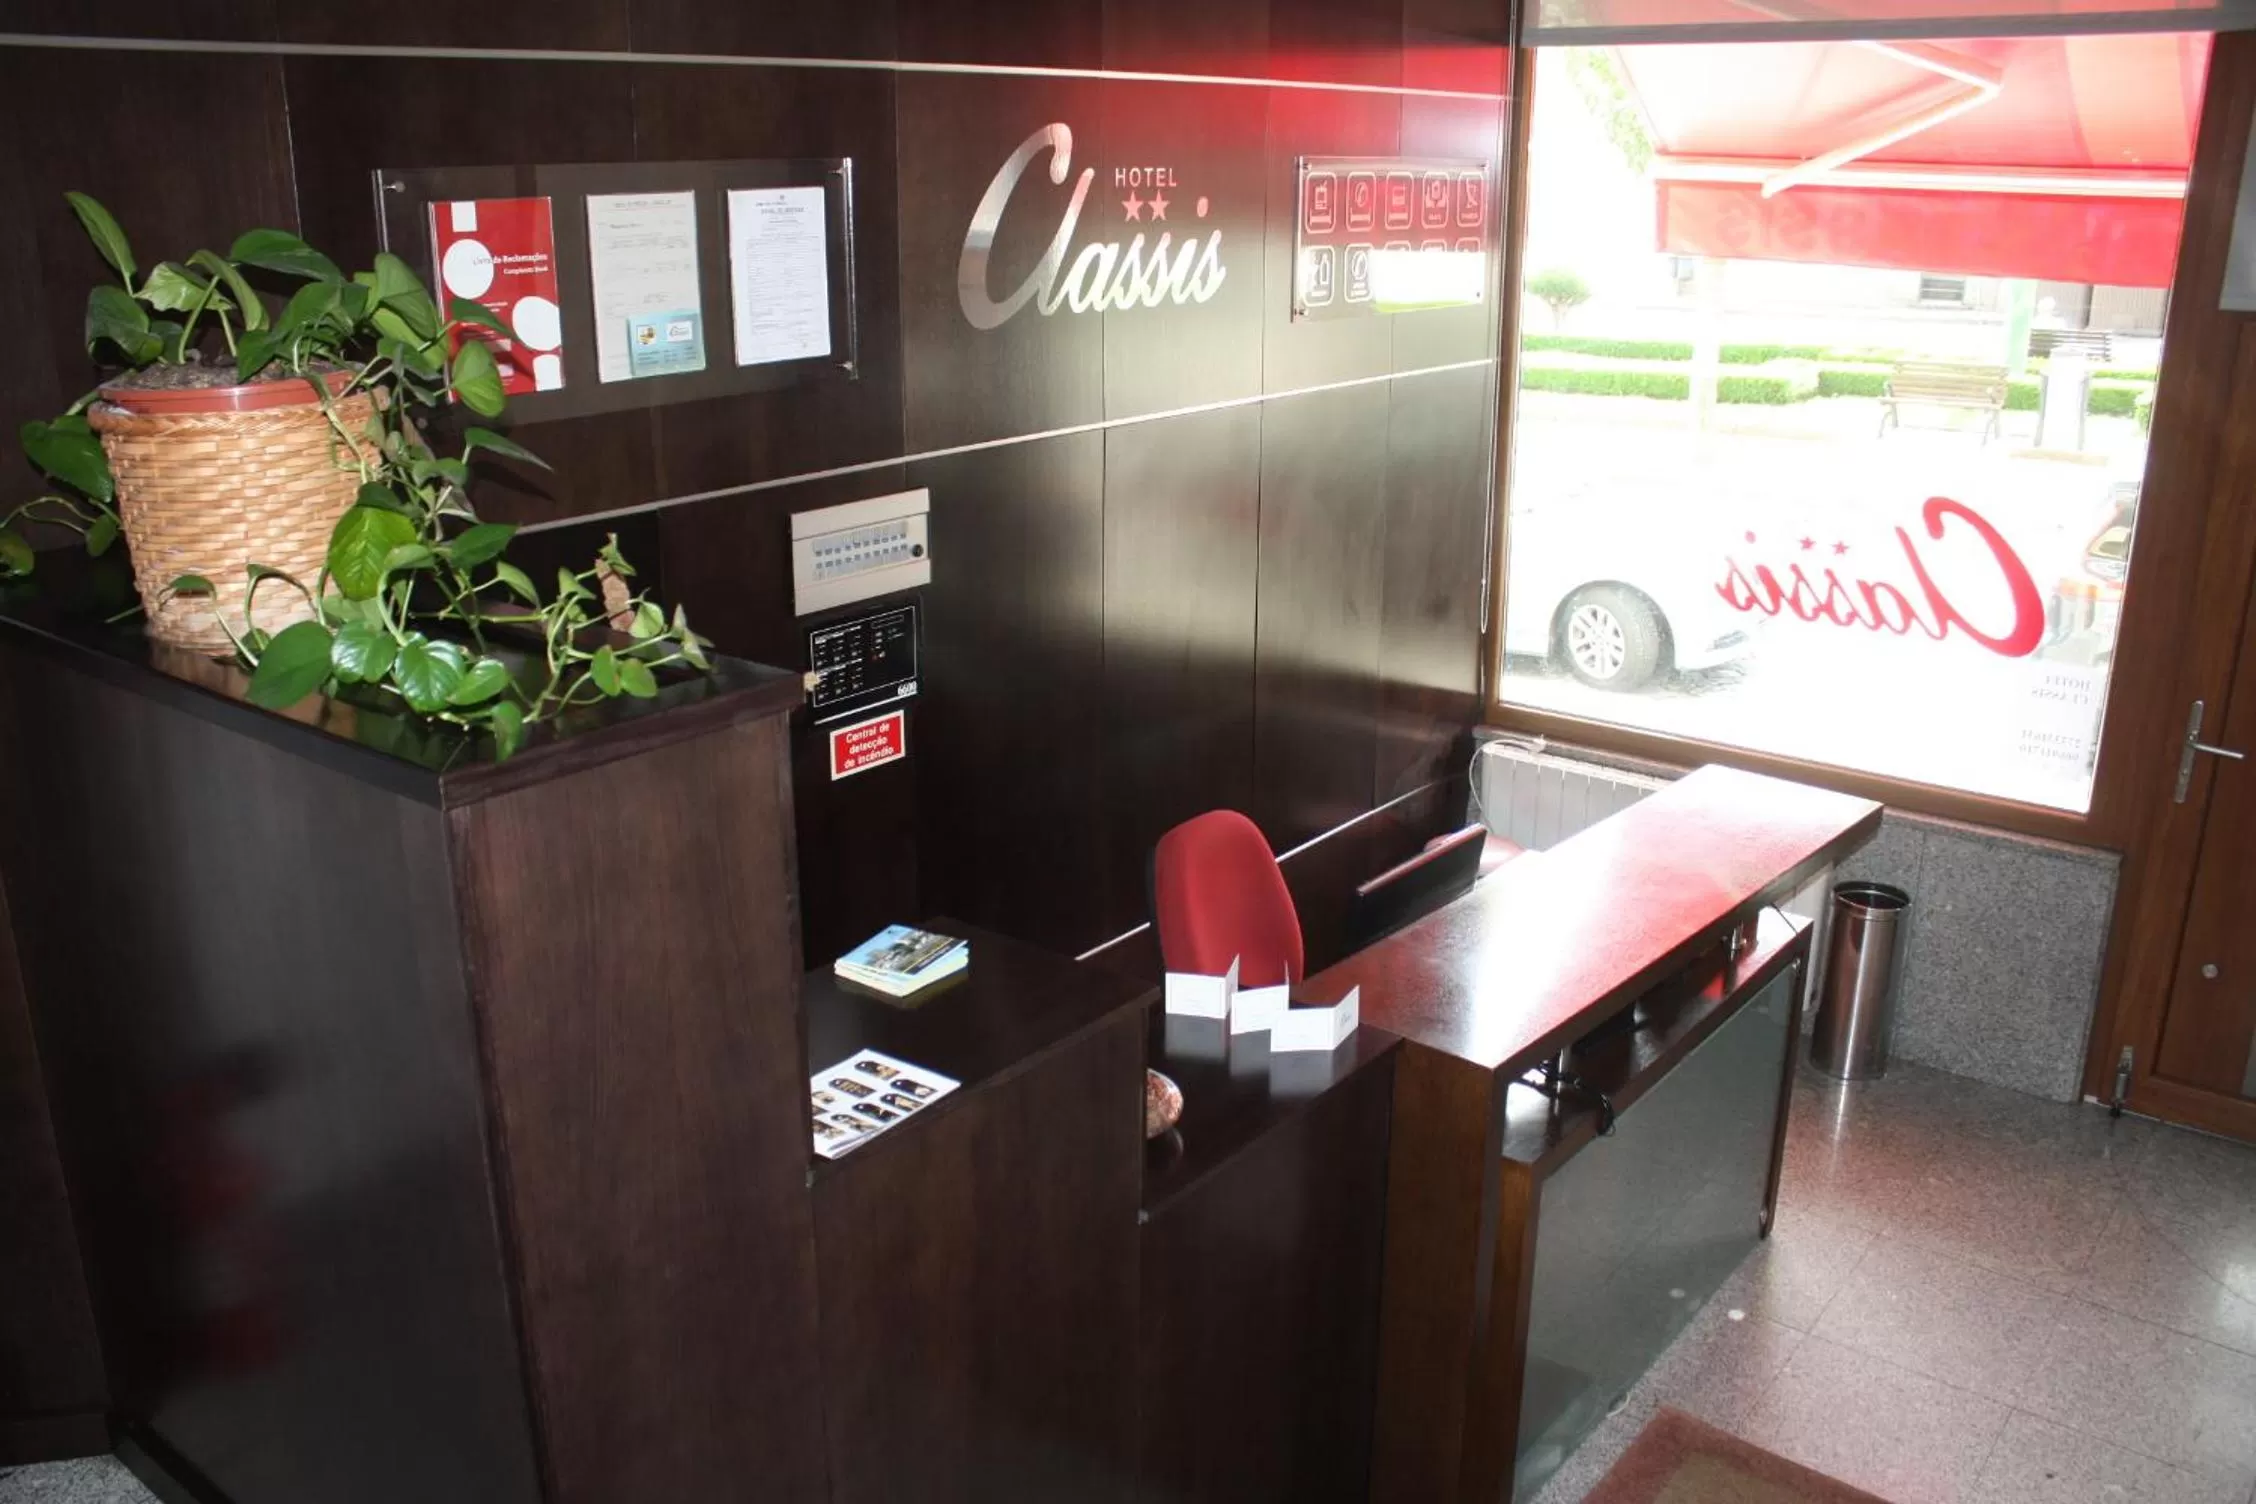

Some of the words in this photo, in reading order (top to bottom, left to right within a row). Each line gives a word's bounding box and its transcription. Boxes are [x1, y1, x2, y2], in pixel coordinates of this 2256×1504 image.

[1115, 167, 1177, 187] HOTEL
[957, 122, 1226, 330] Classis
[493, 255, 502, 264] de
[846, 726, 876, 743] Central
[880, 723, 890, 733] de
[849, 735, 888, 754] detecção
[844, 759, 856, 769] de
[857, 746, 894, 765] incêndio
